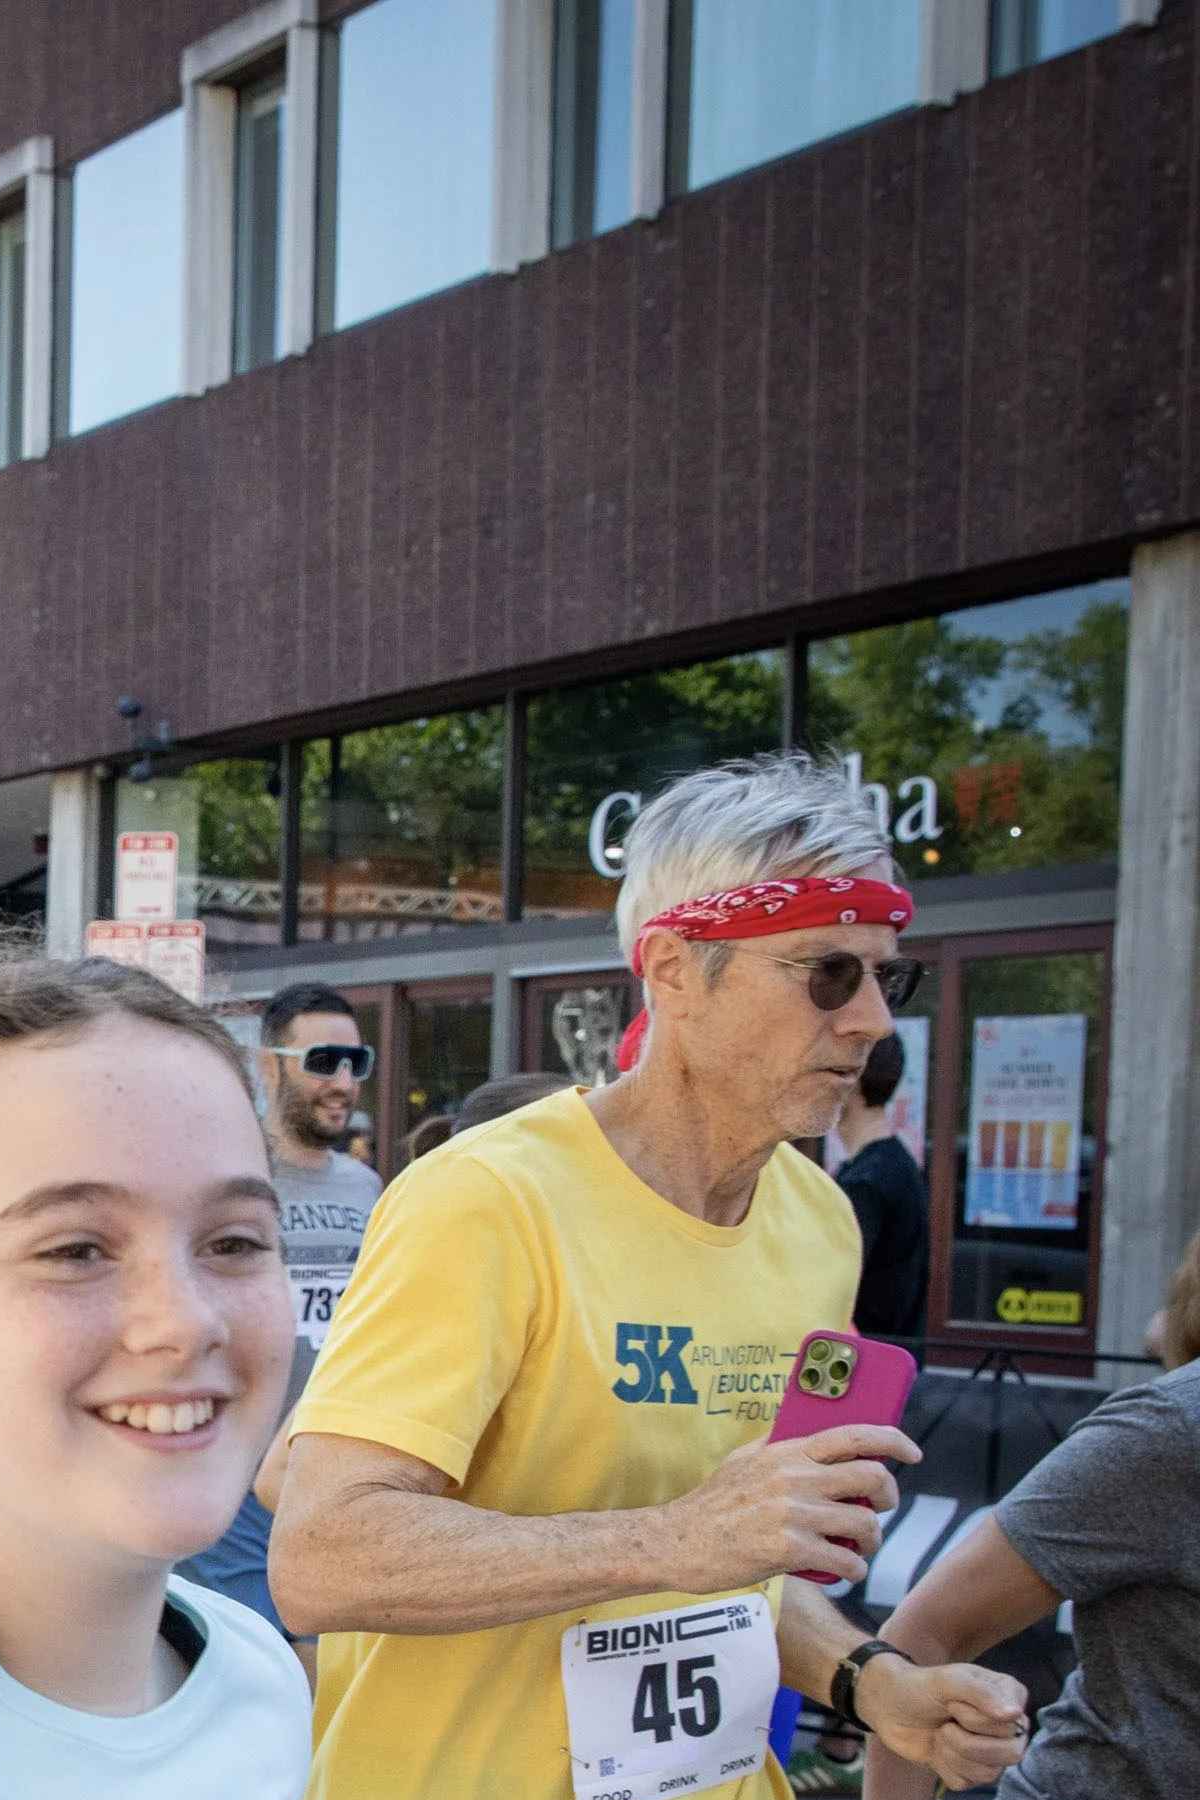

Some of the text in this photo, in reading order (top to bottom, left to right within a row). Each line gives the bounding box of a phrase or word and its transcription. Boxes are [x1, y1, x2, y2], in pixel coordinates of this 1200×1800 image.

[302, 1287, 346, 1322] 73
[612, 1322, 699, 1405] 5K
[690, 1344, 777, 1367] ARLINGTON
[717, 1373, 787, 1394] EDUCATI
[735, 1400, 782, 1422] FOU
[586, 1607, 729, 1655] BIONIC
[632, 1654, 722, 1744] 45
[659, 1773, 699, 1793] DRINK
[720, 1754, 756, 1775] DRINK
